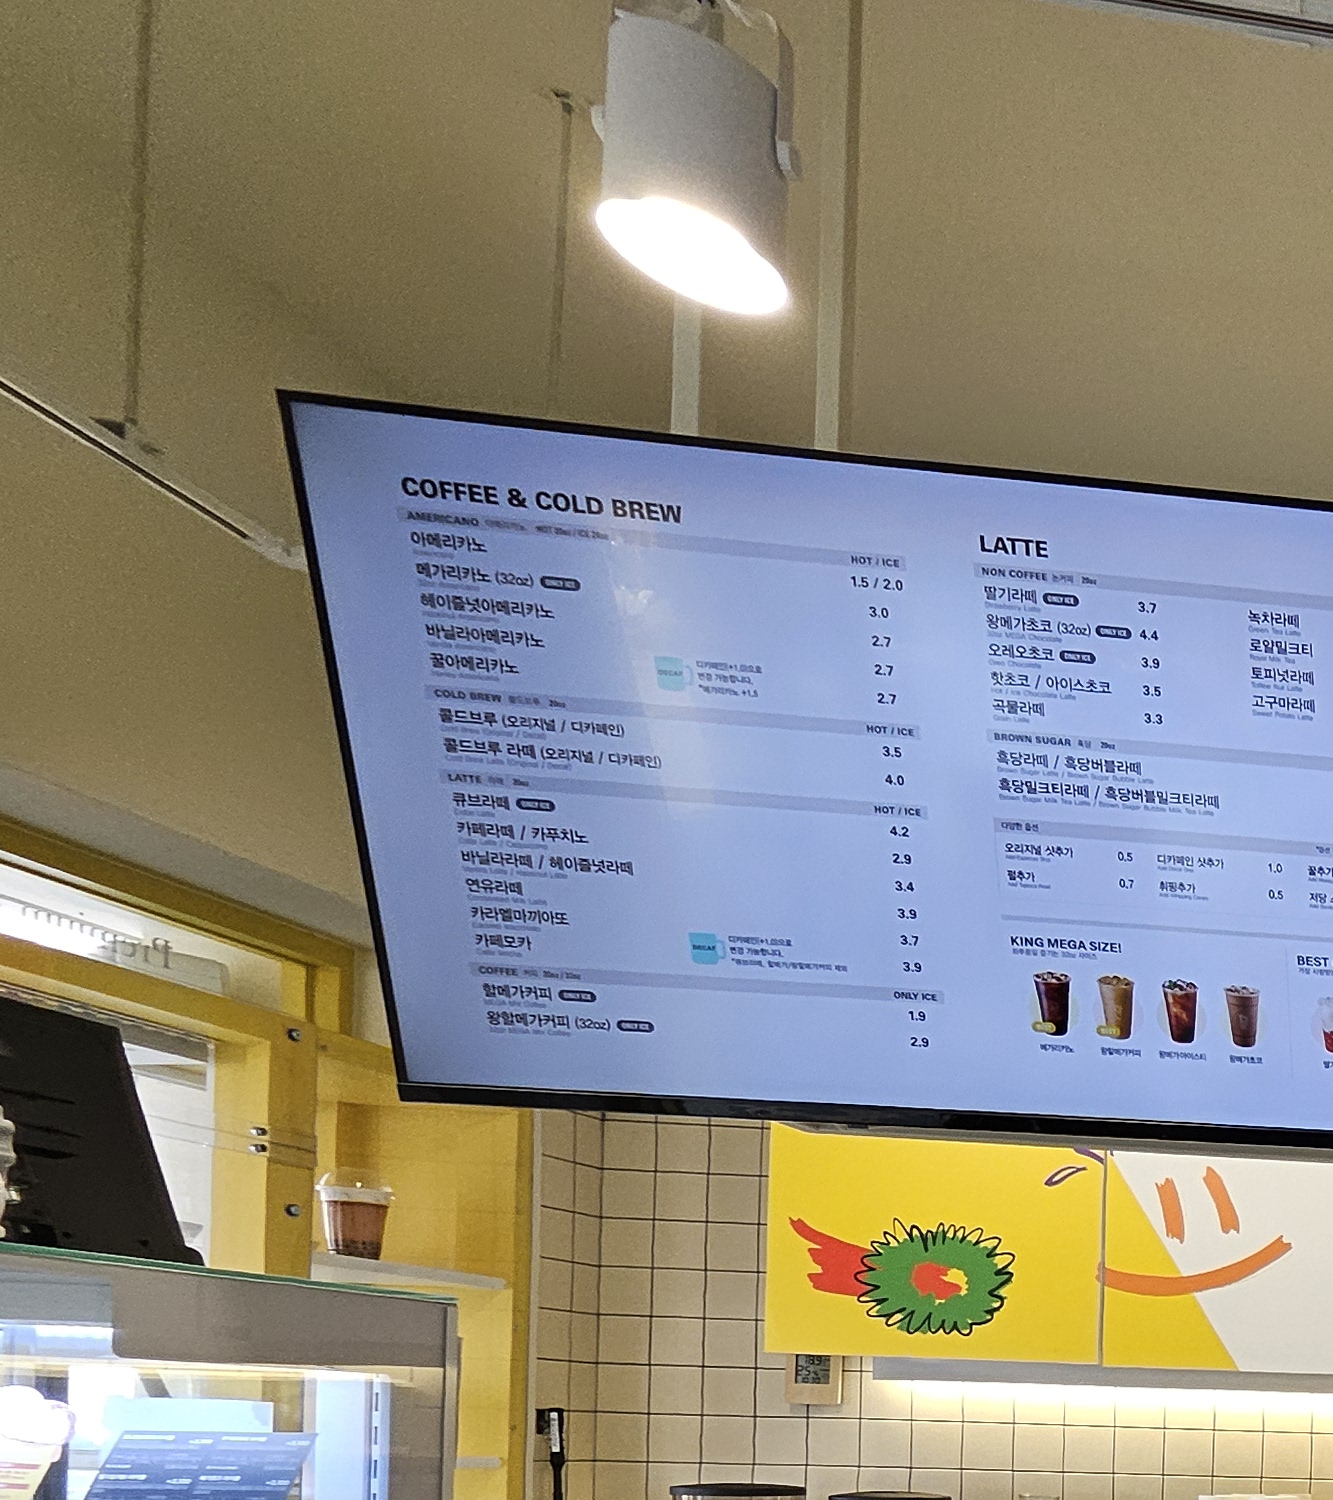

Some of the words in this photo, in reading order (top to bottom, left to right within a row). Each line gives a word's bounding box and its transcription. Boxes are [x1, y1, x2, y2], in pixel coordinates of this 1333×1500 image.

[400, 476, 499, 506] COFFEE
[507, 488, 529, 508] &
[535, 492, 604, 516] COLD
[611, 499, 682, 524] BREW
[406, 511, 480, 527] AMERICANO
[410, 530, 488, 554] 아메리카노
[979, 535, 1049, 559] LATTE
[415, 561, 491, 585] 메가리카노
[494, 571, 535, 589] (32oz)
[982, 566, 1006, 577] NON
[1009, 569, 1048, 581] COFFEE
[984, 584, 1037, 606] 딸기라떼
[868, 605, 889, 619] 3.0
[1137, 601, 1157, 615] 3.7
[1248, 610, 1300, 629] 녹차라떼
[1139, 629, 1159, 642] 4.4
[988, 642, 1055, 662] 오레오초코
[991, 671, 1029, 689] 핫초코
[1045, 675, 1112, 695] 아이스초코
[434, 688, 464, 701] COLD
[469, 692, 502, 704] BREW
[1251, 694, 1316, 714] 고구마라떼
[1144, 713, 1163, 726] 3.3
[993, 731, 1032, 744] BROWN
[1035, 735, 1071, 748] SUGAR
[882, 745, 902, 759] 3.5
[448, 773, 482, 784] LATTE
[457, 821, 515, 841] 카페라떼
[531, 826, 589, 846] 카푸치노
[890, 825, 909, 839] 4.2
[1117, 851, 1134, 863] 0.5
[1010, 936, 1044, 949] KING
[1047, 938, 1087, 952] MEGA
[1088, 941, 1122, 954] SIZE!
[1297, 956, 1330, 969] BEST
[908, 1010, 926, 1024] 1.9
[910, 1036, 930, 1050] 2.9
